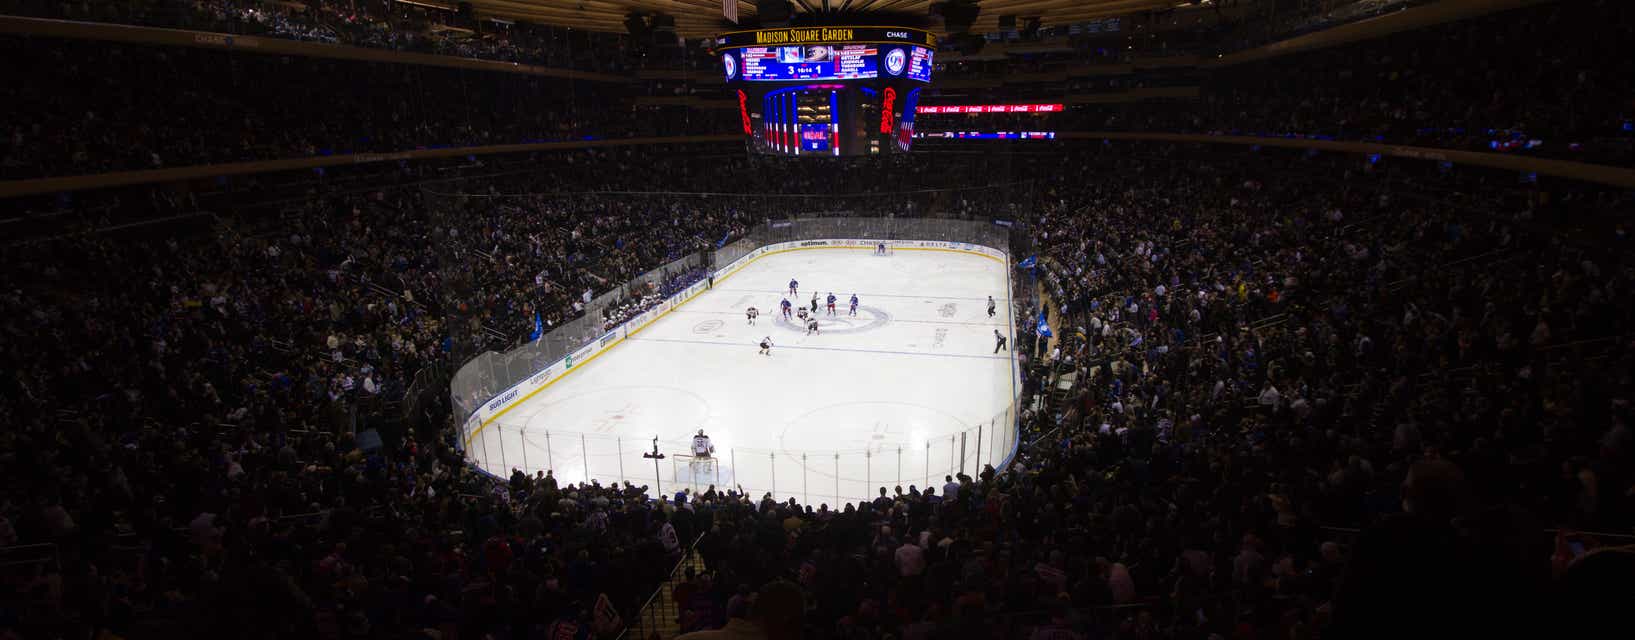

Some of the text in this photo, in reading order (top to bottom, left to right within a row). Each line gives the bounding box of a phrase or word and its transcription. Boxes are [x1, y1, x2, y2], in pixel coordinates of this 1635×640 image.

[757, 28, 853, 43] MADISON SQUARE GARDEN
[788, 66, 794, 74] 3
[816, 65, 821, 74] 1
[501, 390, 519, 404] LIGHT
